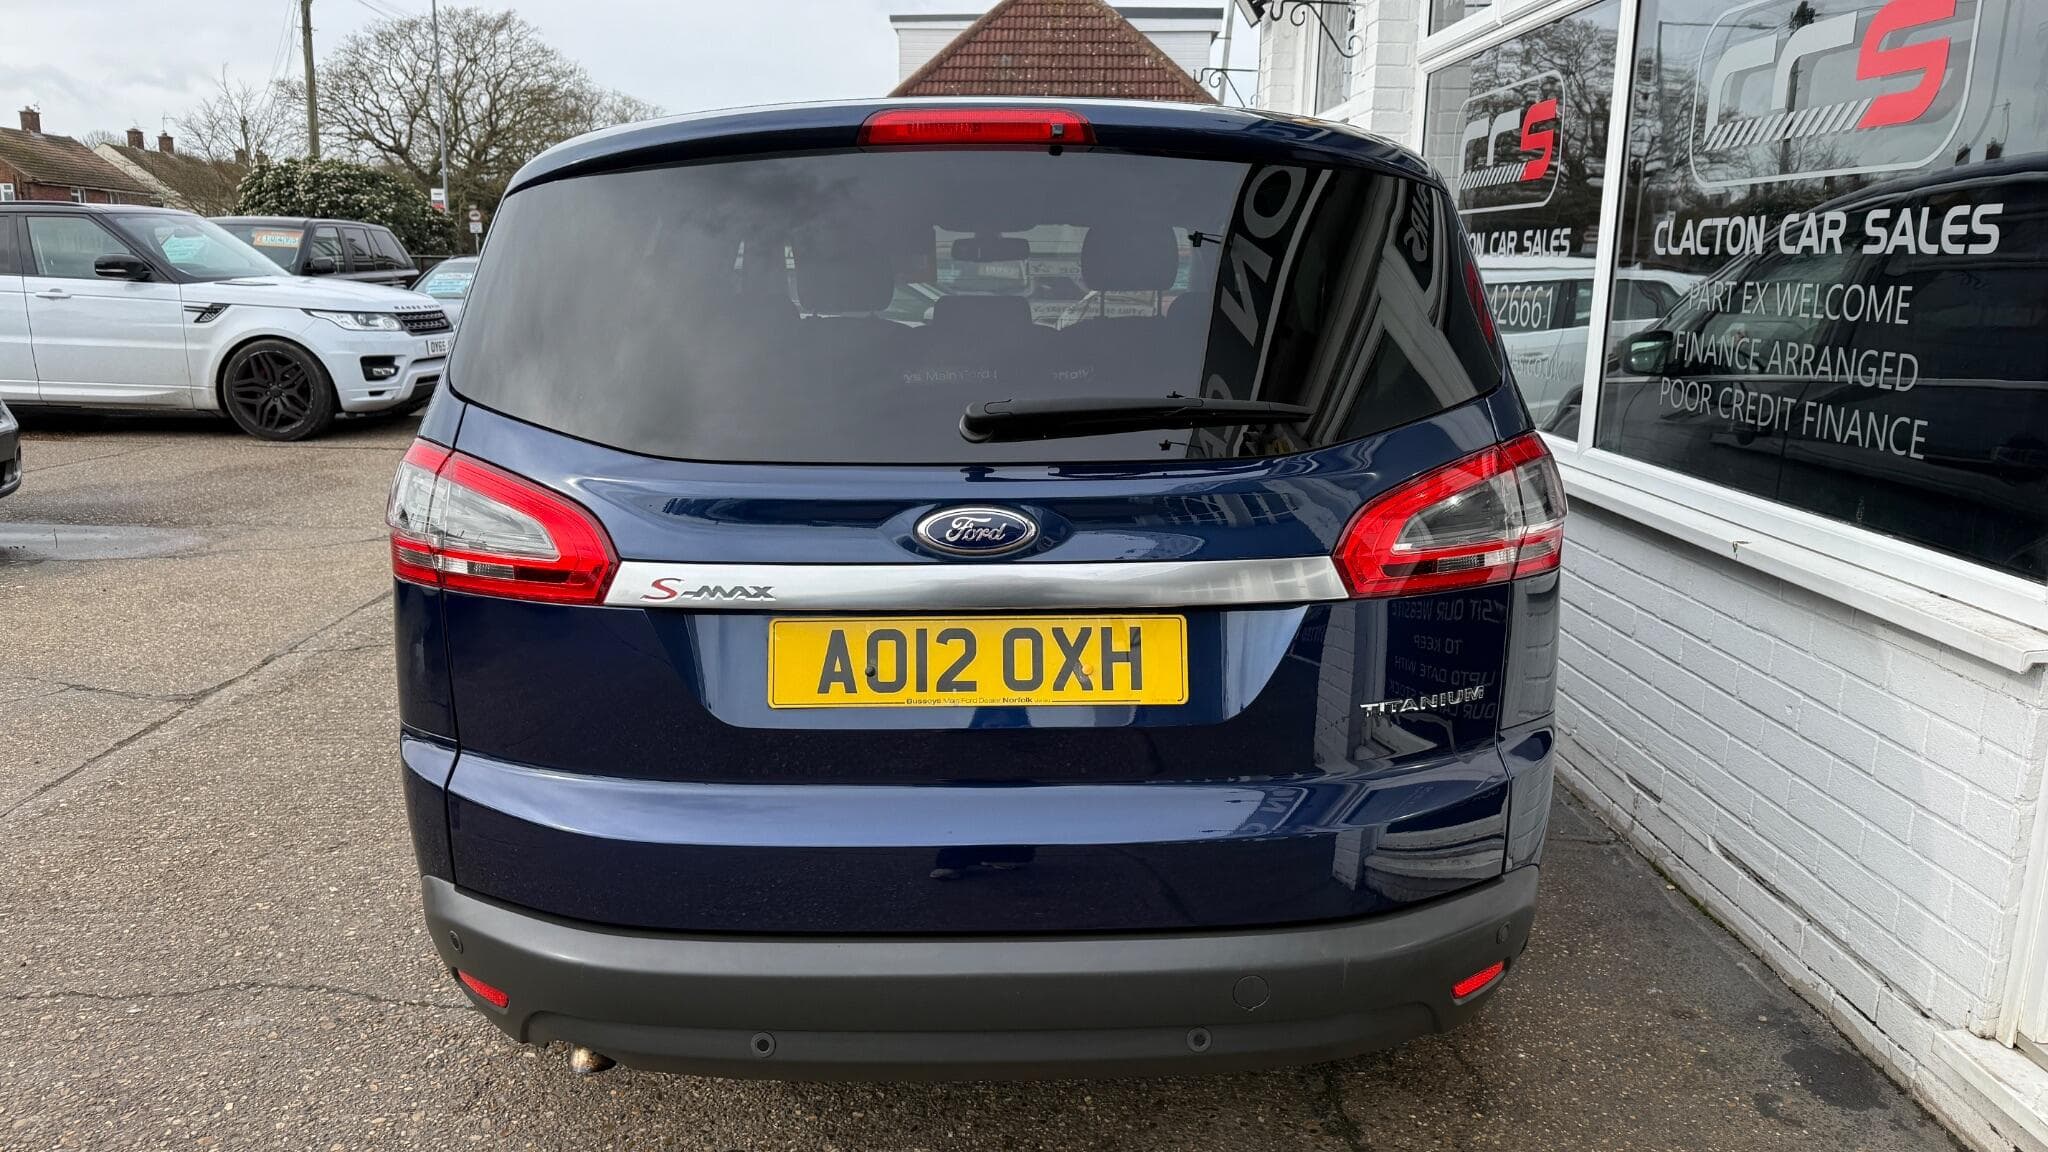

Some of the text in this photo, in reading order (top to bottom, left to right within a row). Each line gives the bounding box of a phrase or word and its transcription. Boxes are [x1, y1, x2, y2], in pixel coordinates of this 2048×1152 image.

[1490, 230, 1518, 257] CAR
[1522, 227, 1572, 257] SALES
[1653, 203, 2004, 256] CLACTON CAR SALES
[1688, 281, 1914, 325] PART EX WELCOME
[1674, 330, 1920, 392] FINANCE ARRANGED
[1659, 376, 1929, 460] POOR CREDIT FINANCE
[944, 515, 1007, 545] Ford
[640, 577, 777, 602] S-MAX
[817, 625, 1143, 695] AO12 OXH
[1002, 696, 1033, 704] Norfolk
[1360, 685, 1485, 717] TITANIUM
